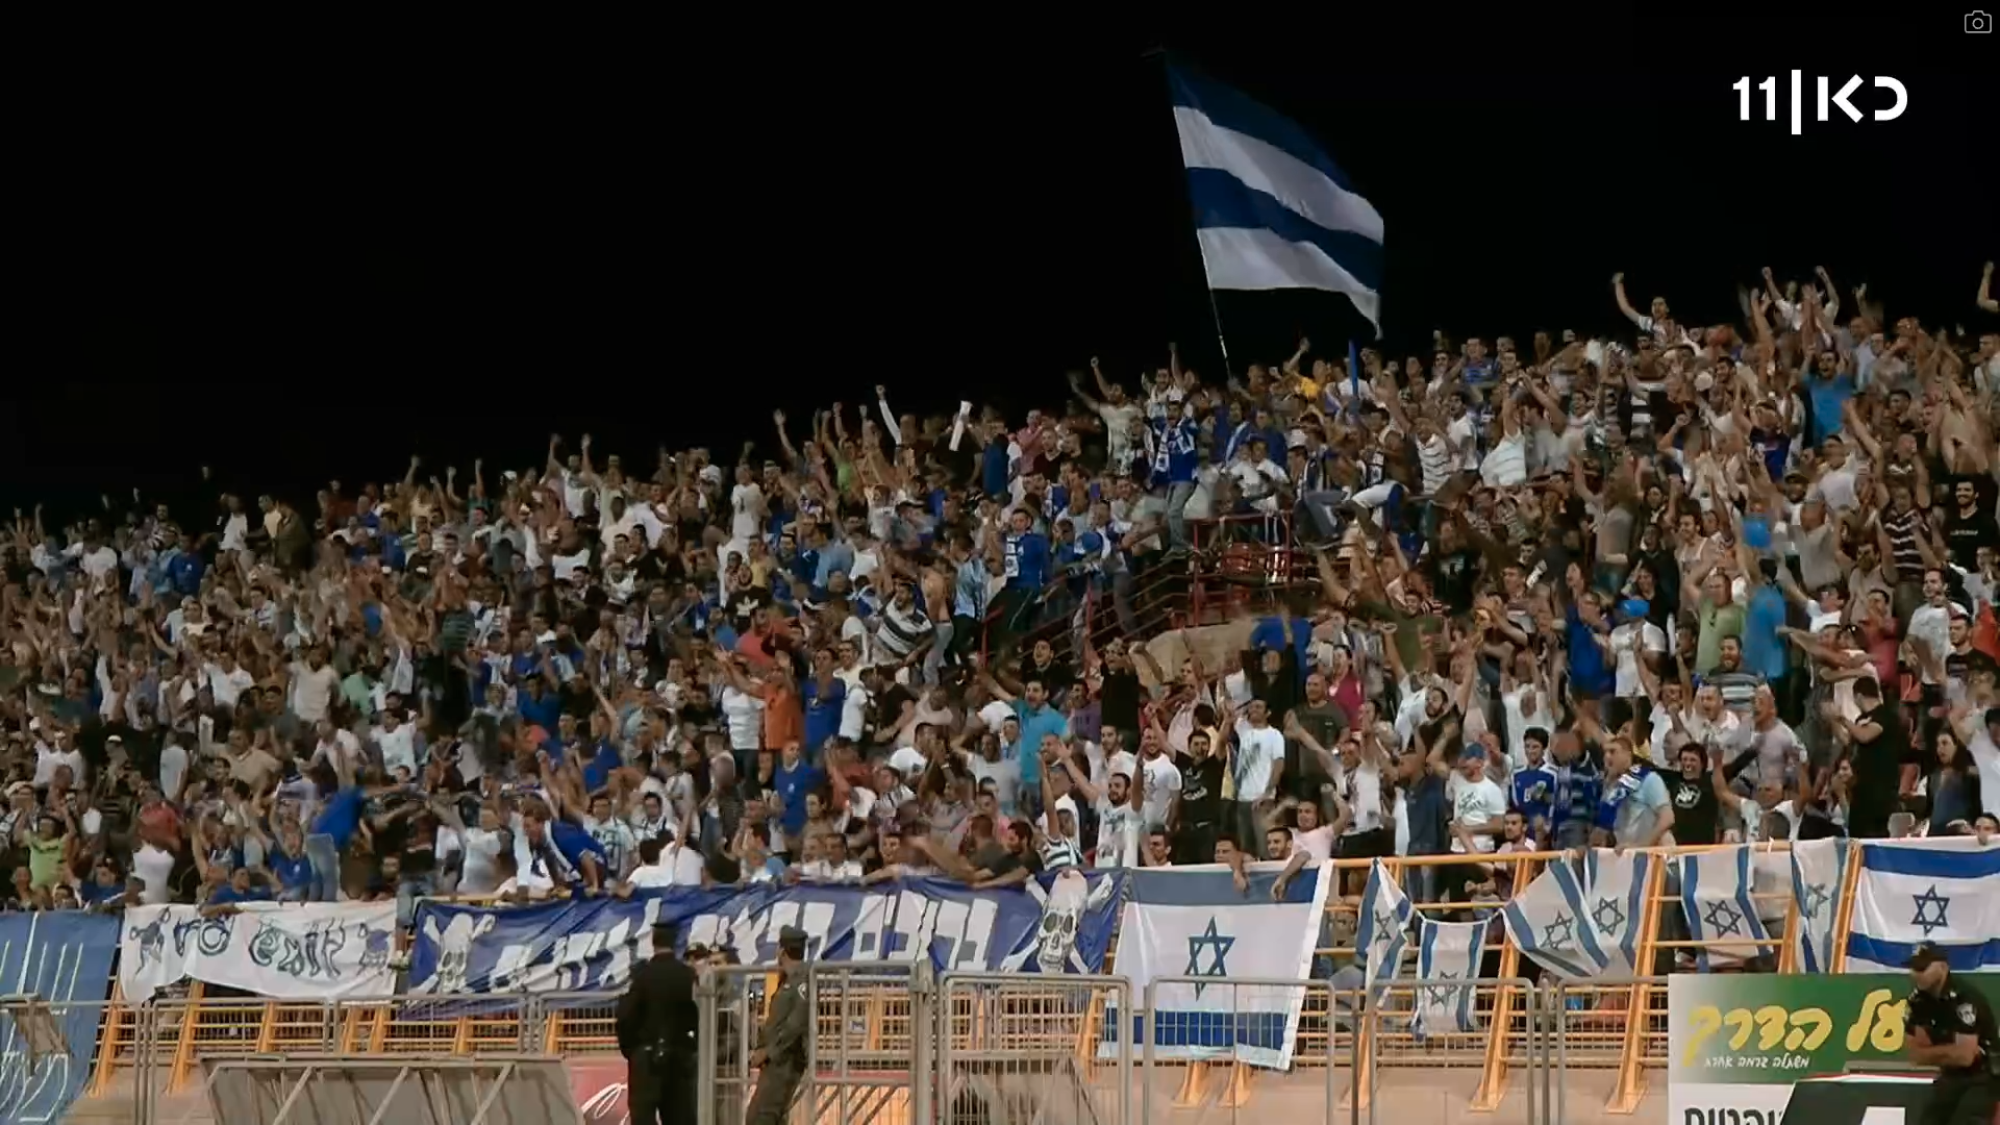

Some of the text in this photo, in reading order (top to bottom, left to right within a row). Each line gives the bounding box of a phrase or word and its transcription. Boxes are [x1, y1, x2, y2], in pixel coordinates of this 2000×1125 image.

[1682, 988, 1908, 1068] על הדרך
[1737, 1055, 1769, 1069] ברמה
